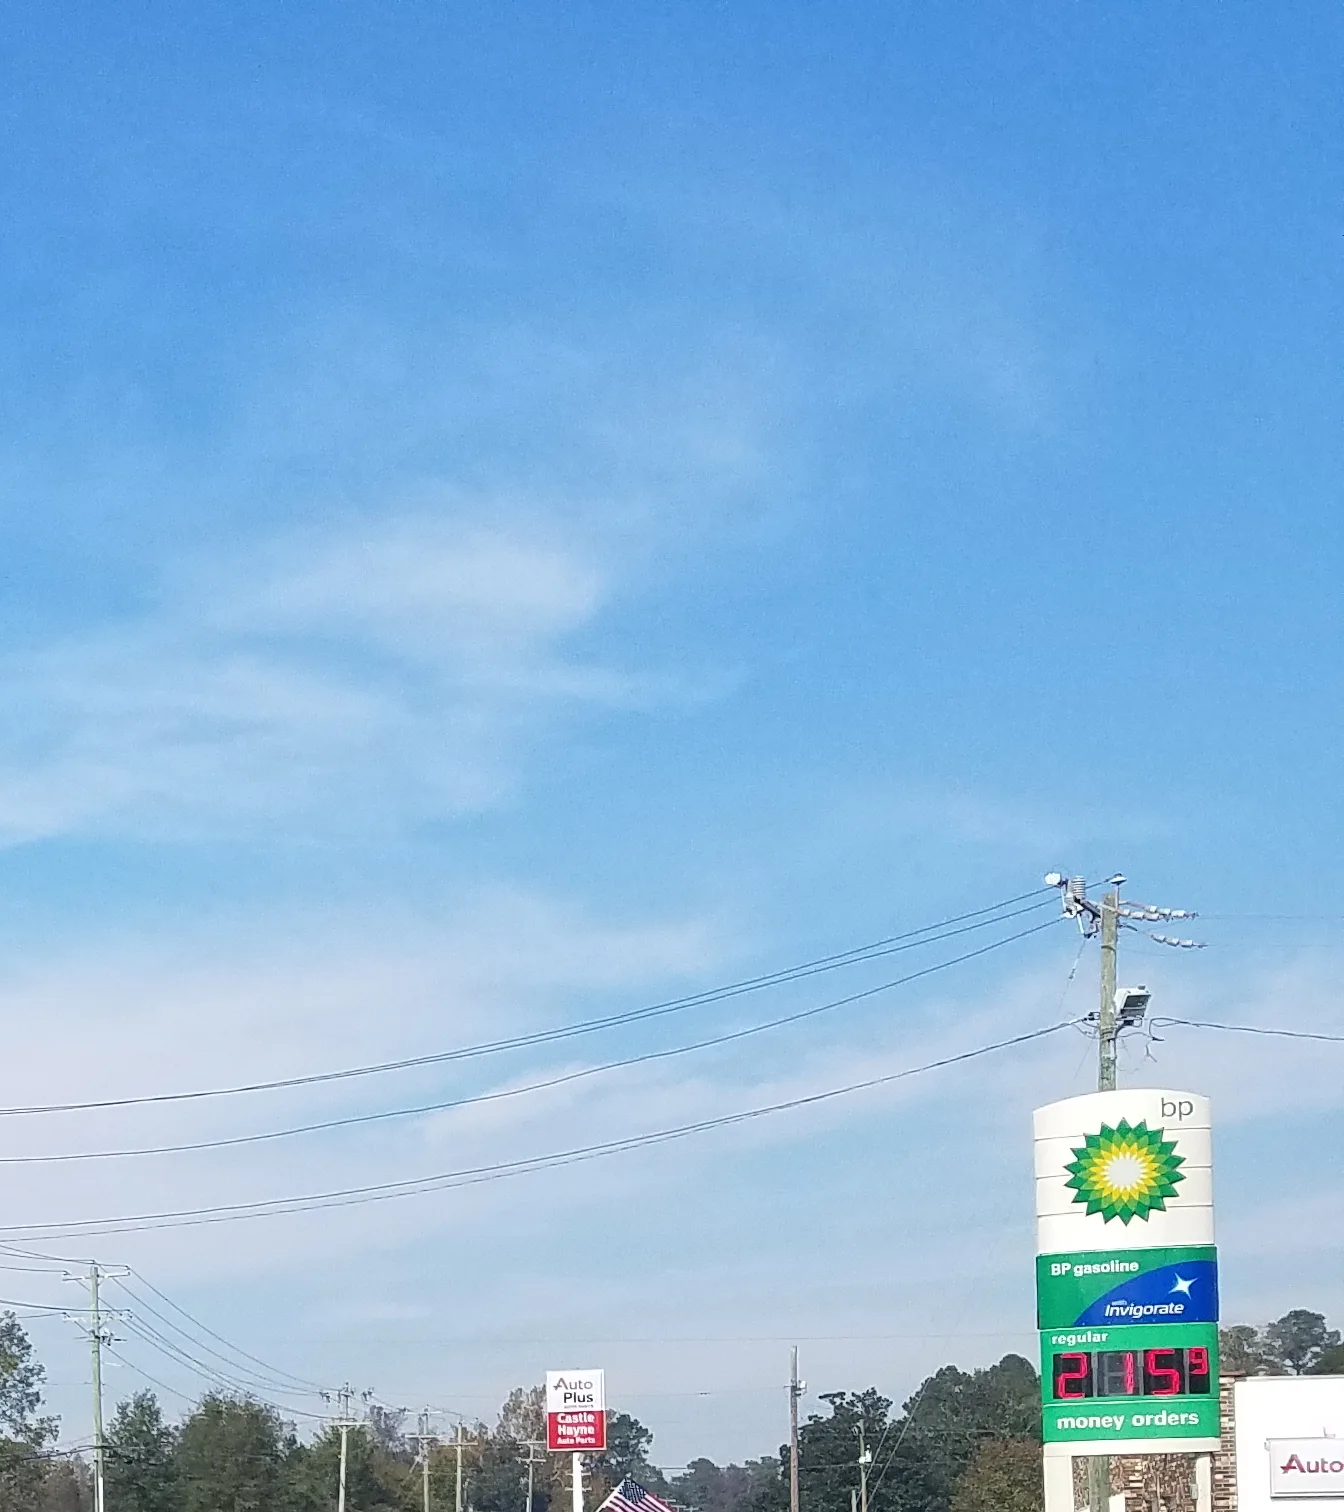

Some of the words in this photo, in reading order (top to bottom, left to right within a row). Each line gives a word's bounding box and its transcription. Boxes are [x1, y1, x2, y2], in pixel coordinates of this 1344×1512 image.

[1161, 1097, 1194, 1121] bp
[1051, 1263, 1072, 1276] BP
[1073, 1260, 1140, 1277] gasoline
[1104, 1303, 1185, 1318] Invigorate
[1051, 1331, 1109, 1346] regular
[553, 1377, 594, 1391] Auto
[563, 1391, 594, 1404] Plus
[557, 1412, 595, 1424] Castle
[1057, 1414, 1126, 1432] money
[1131, 1410, 1200, 1428] orders
[557, 1424, 595, 1437] Hayne
[556, 1437, 575, 1445] Auto
